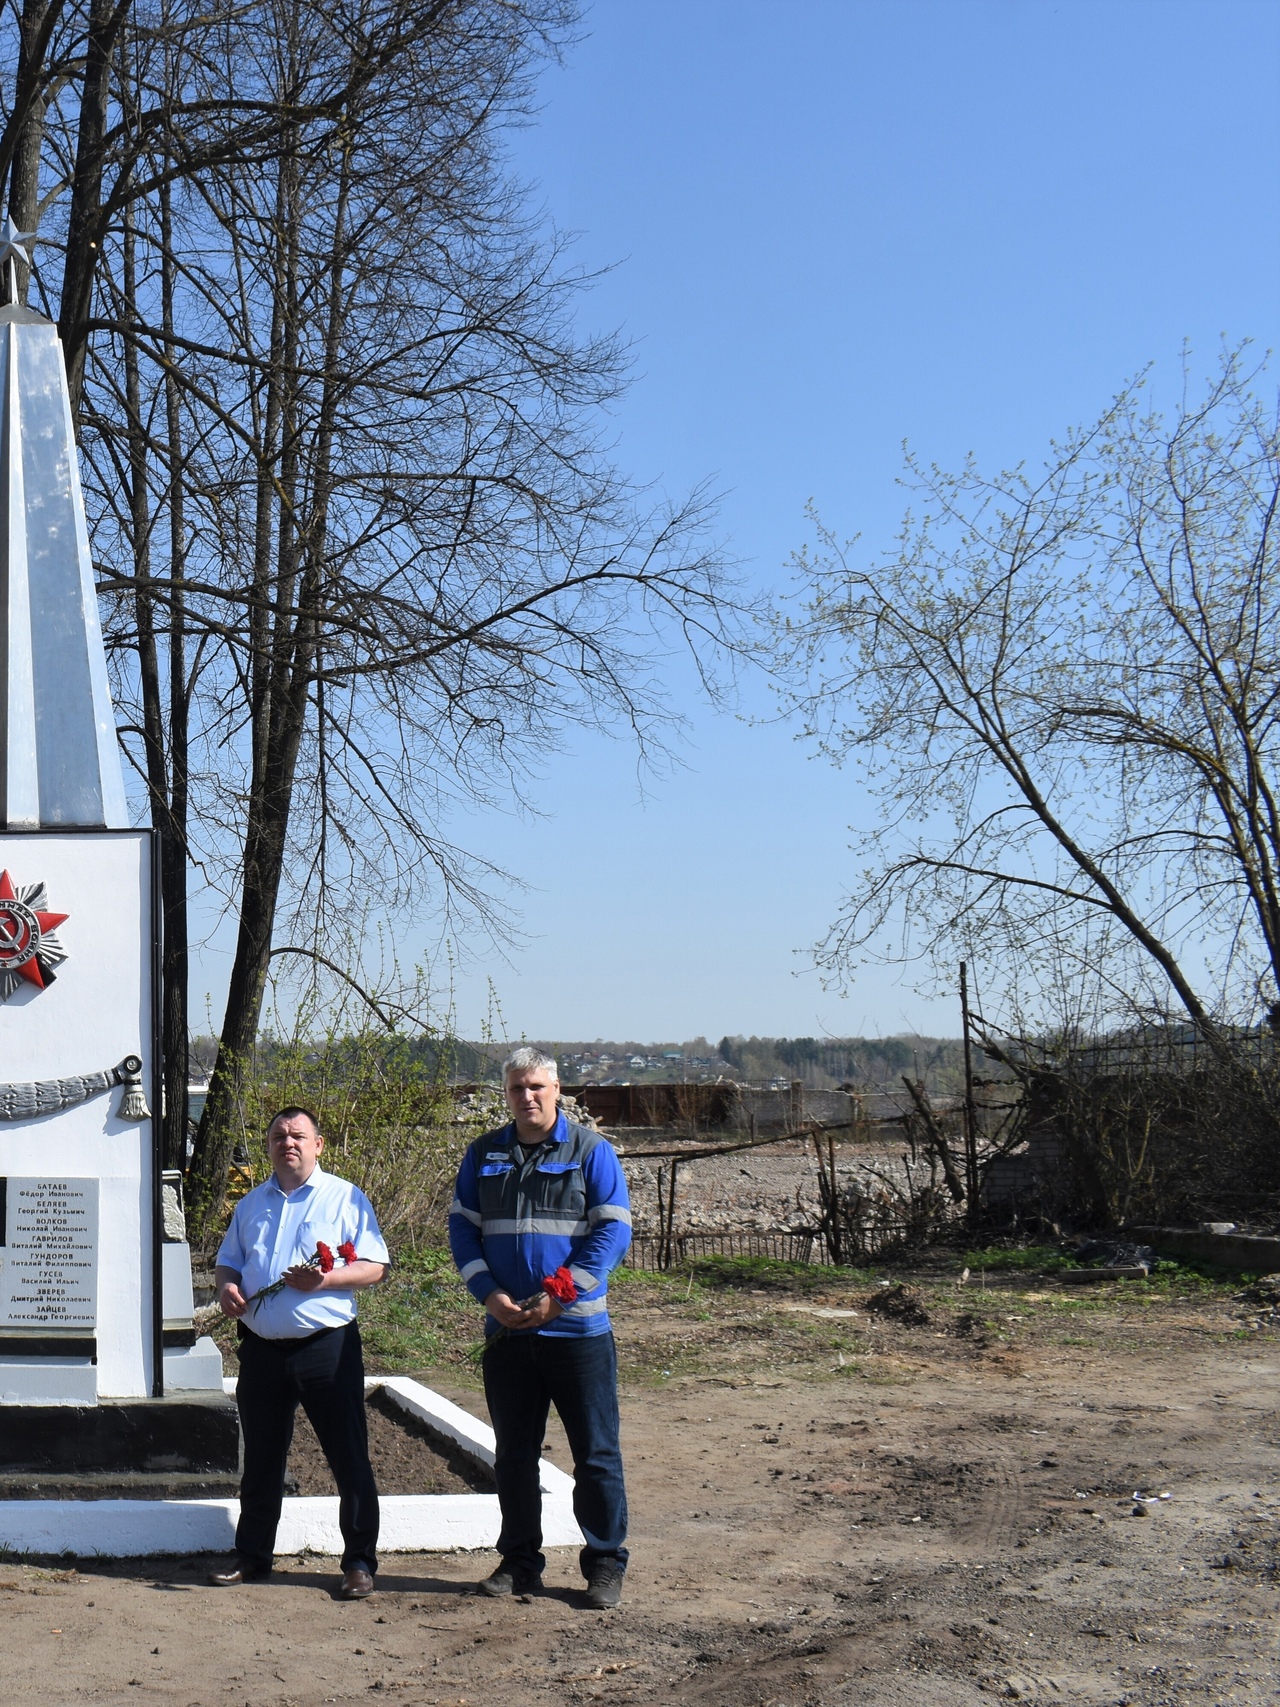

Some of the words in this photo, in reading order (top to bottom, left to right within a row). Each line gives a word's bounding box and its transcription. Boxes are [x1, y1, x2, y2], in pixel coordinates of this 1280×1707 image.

[19, 1190, 45, 1198] Фёдор
[10, 1295, 44, 1303] Дмитрий
[36, 1304, 67, 1313] ЗАЙЦЕВ
[7, 1313, 48, 1321] Александр
